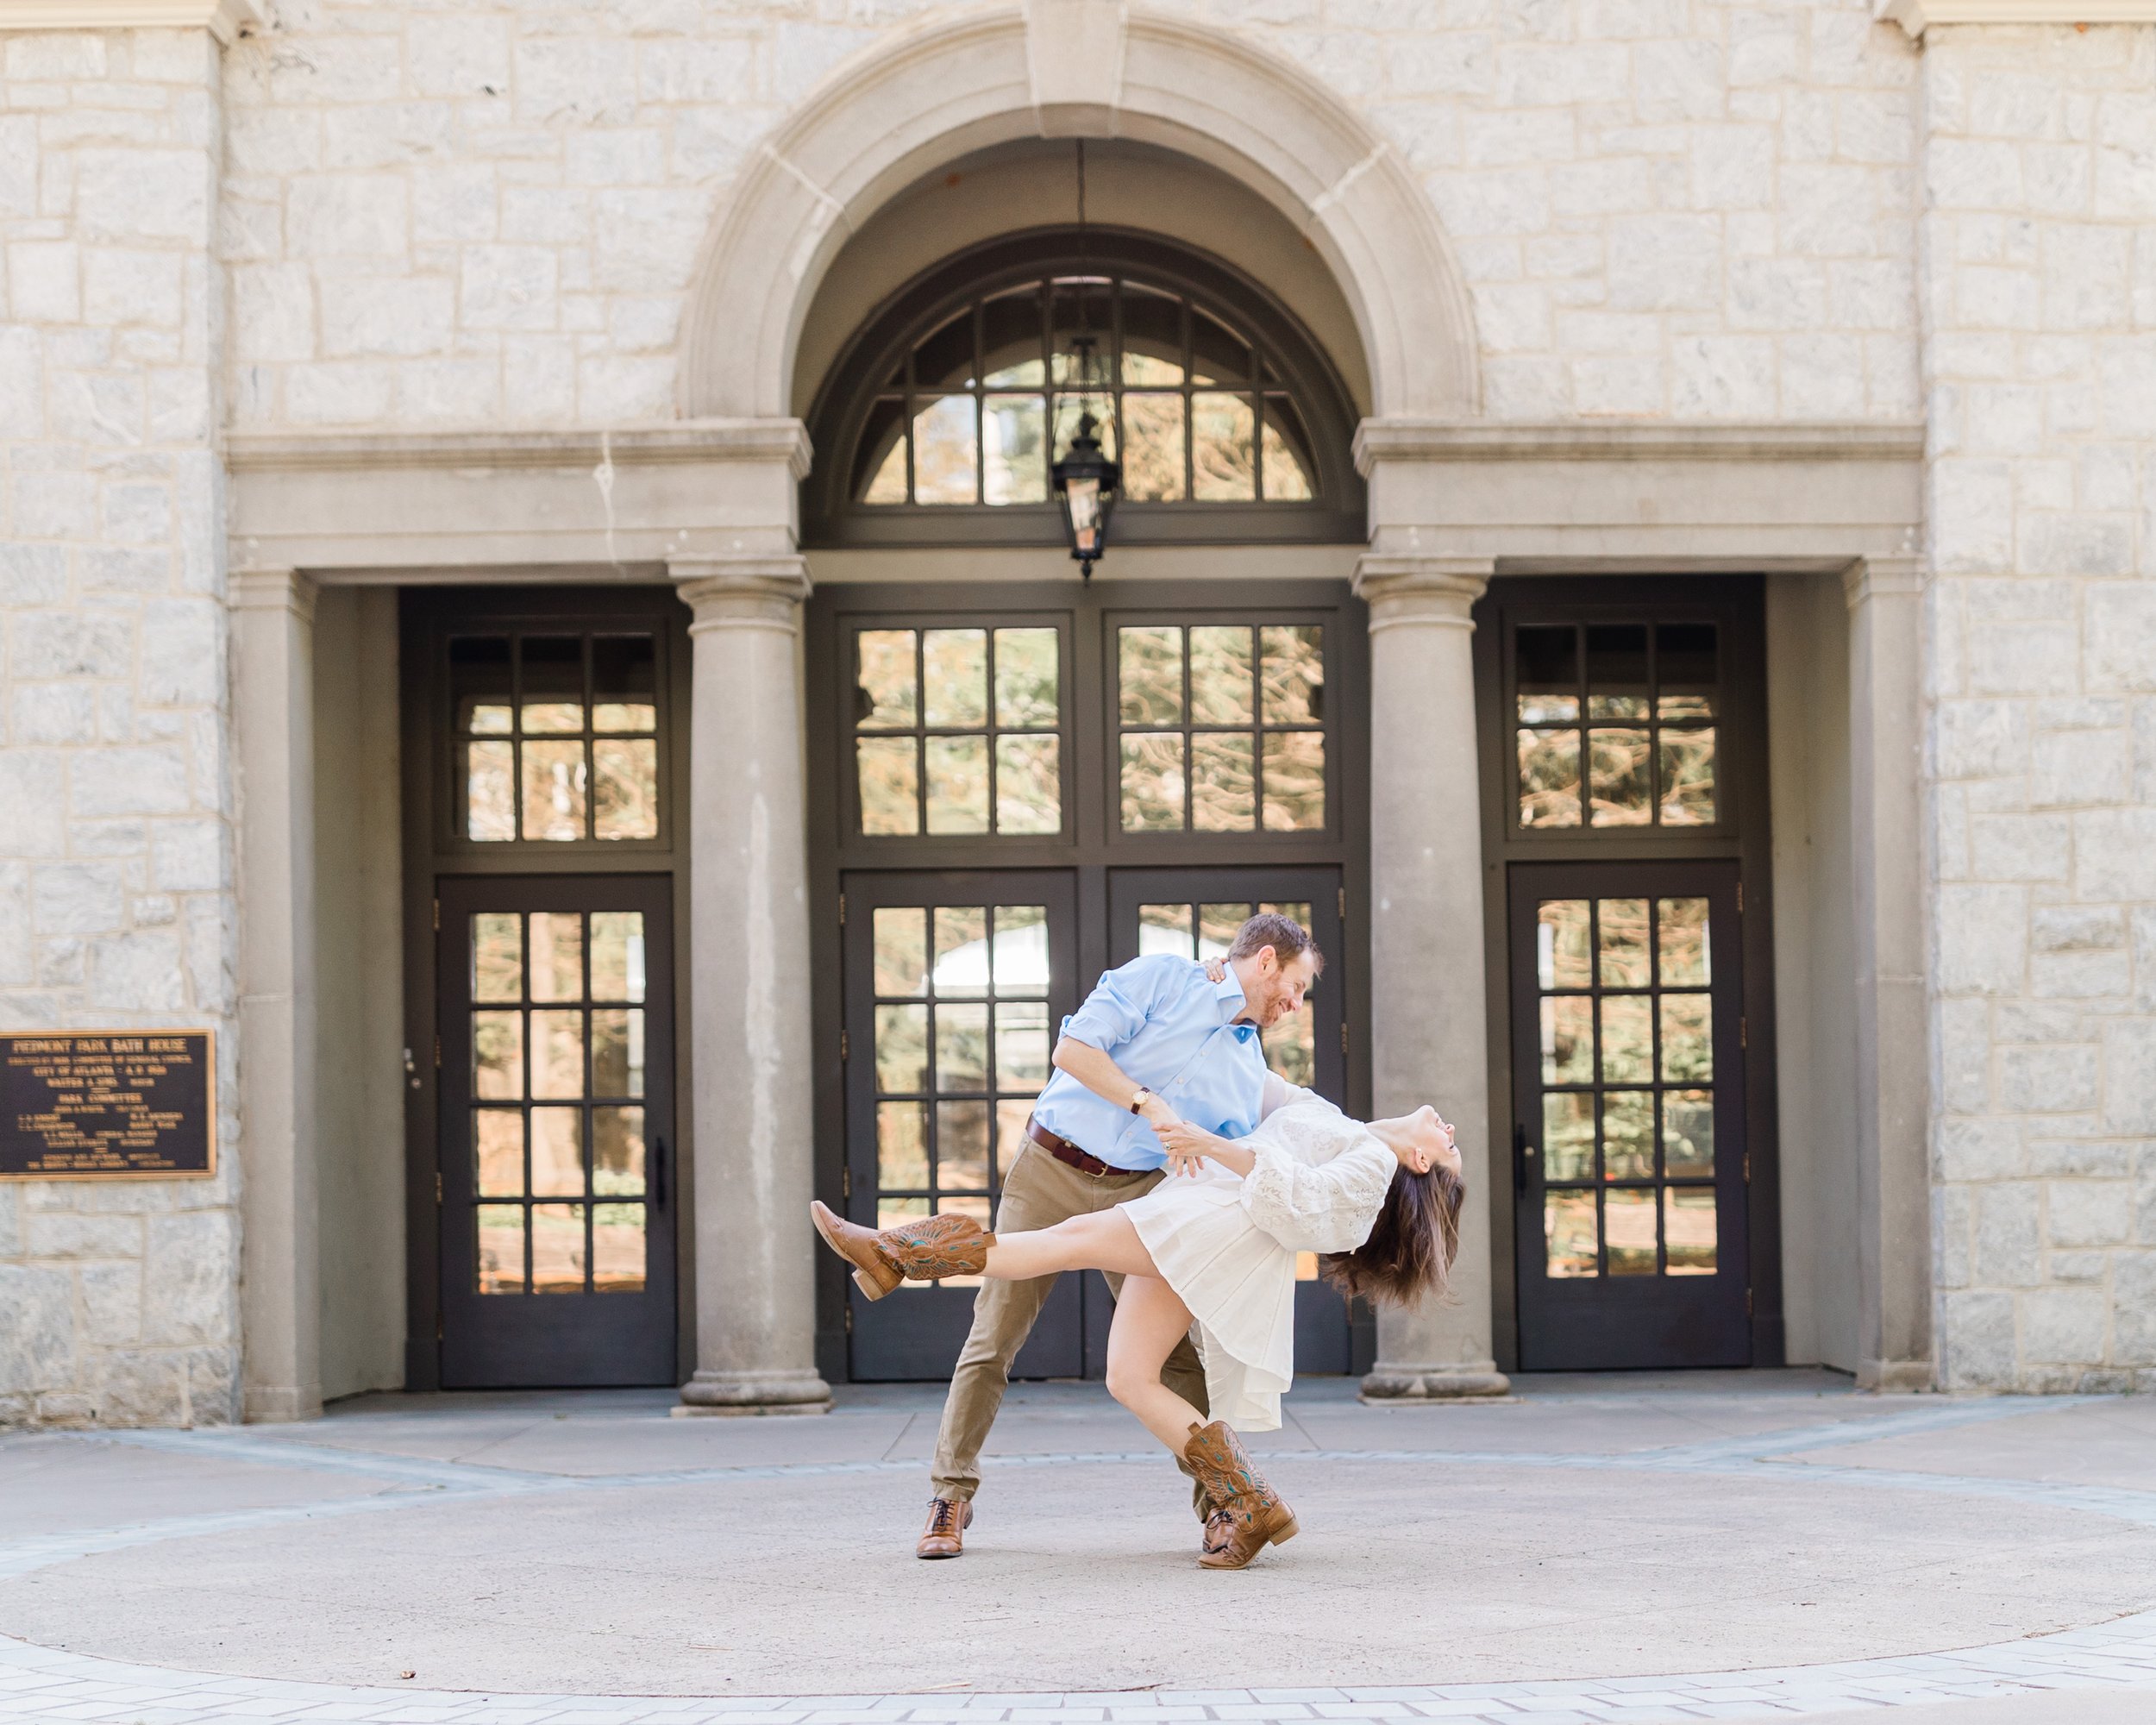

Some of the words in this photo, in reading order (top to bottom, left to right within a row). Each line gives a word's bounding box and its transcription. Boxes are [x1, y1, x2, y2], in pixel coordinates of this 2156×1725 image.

[75, 1038, 109, 1053] PARK
[110, 1038, 144, 1052] BATH
[148, 1038, 187, 1052] HOUSE
